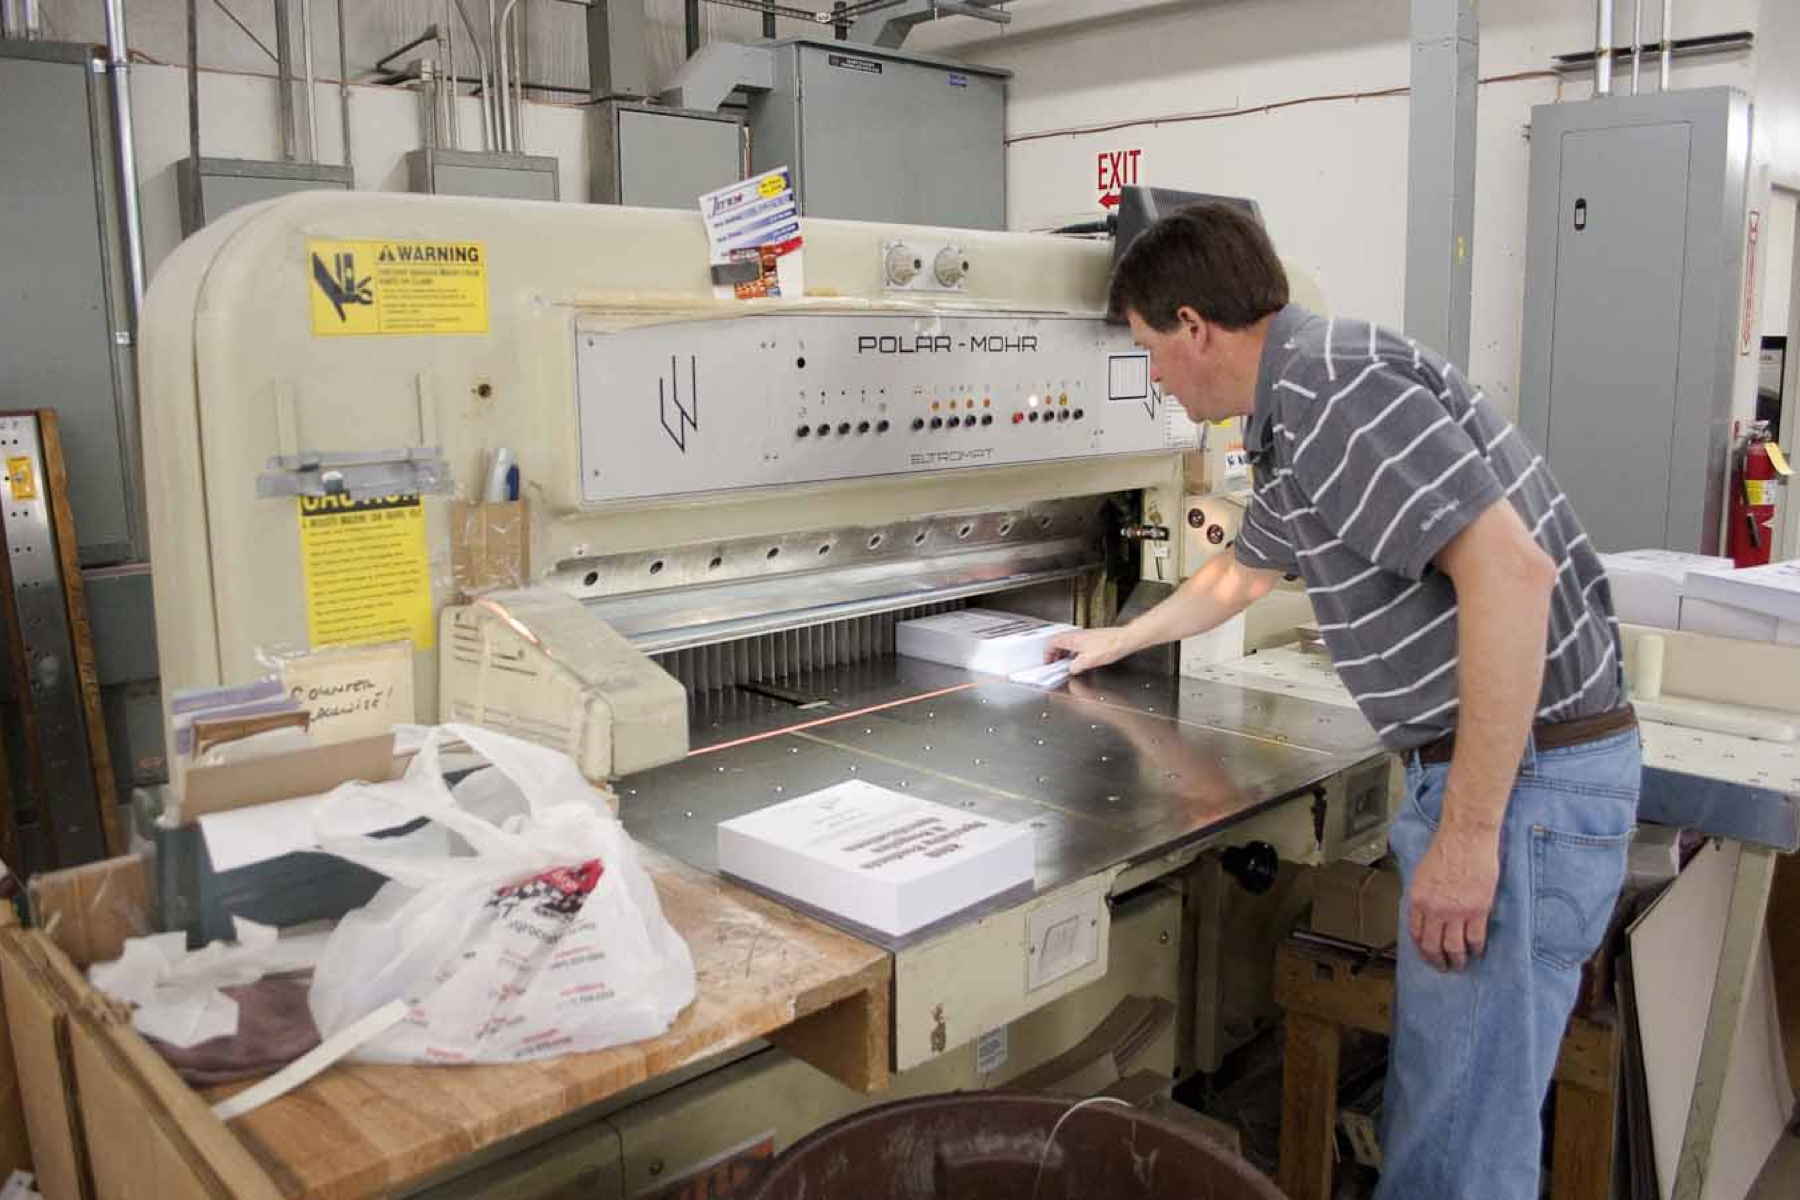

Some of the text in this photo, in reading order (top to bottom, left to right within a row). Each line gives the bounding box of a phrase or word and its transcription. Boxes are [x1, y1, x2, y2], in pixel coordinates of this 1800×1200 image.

[1098, 149, 1141, 189] EXIT
[397, 245, 480, 262] WARNING
[858, 335, 952, 354] POLAR
[970, 335, 1038, 353] MOHR
